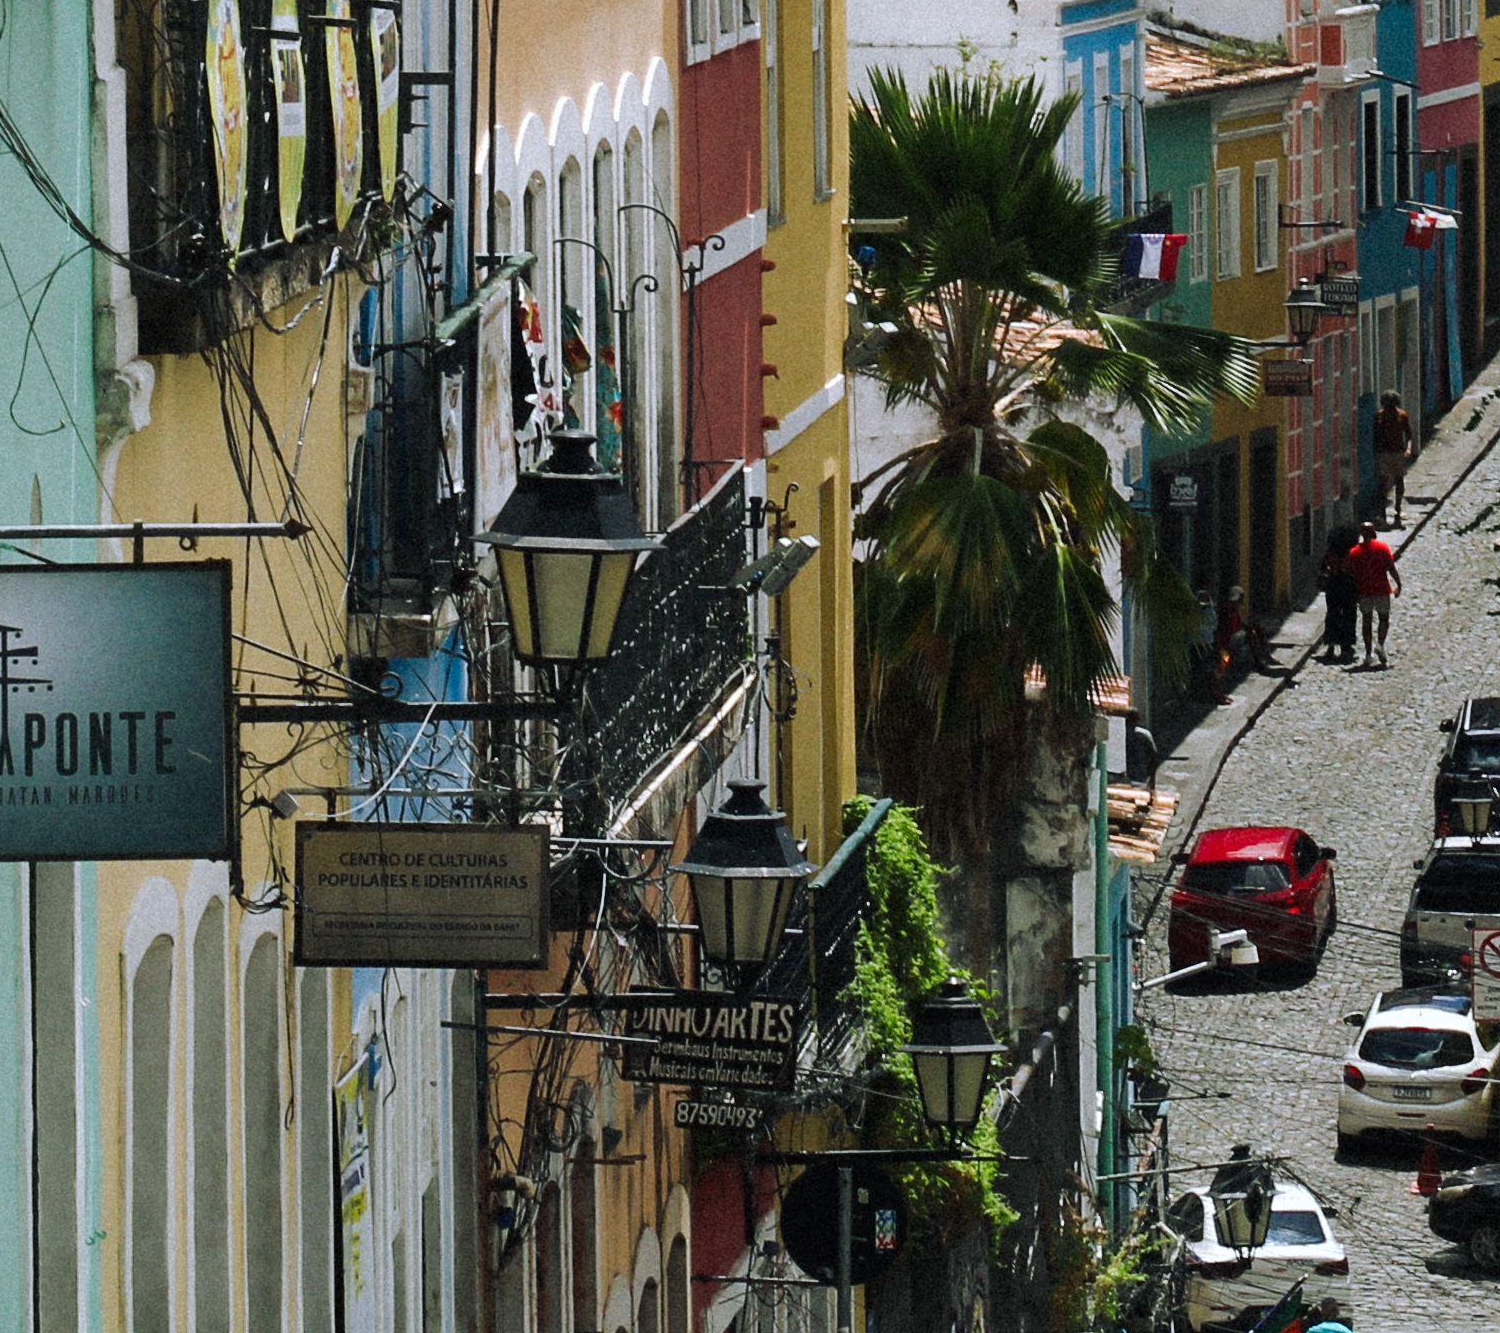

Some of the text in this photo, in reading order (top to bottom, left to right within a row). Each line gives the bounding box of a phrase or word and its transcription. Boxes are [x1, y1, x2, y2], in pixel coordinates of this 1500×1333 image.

[24, 711, 176, 777] PONTE
[339, 852, 508, 868] CENTRO DE CULTURAS
[318, 871, 529, 889] POPULARES E IDENTITÁRIAS
